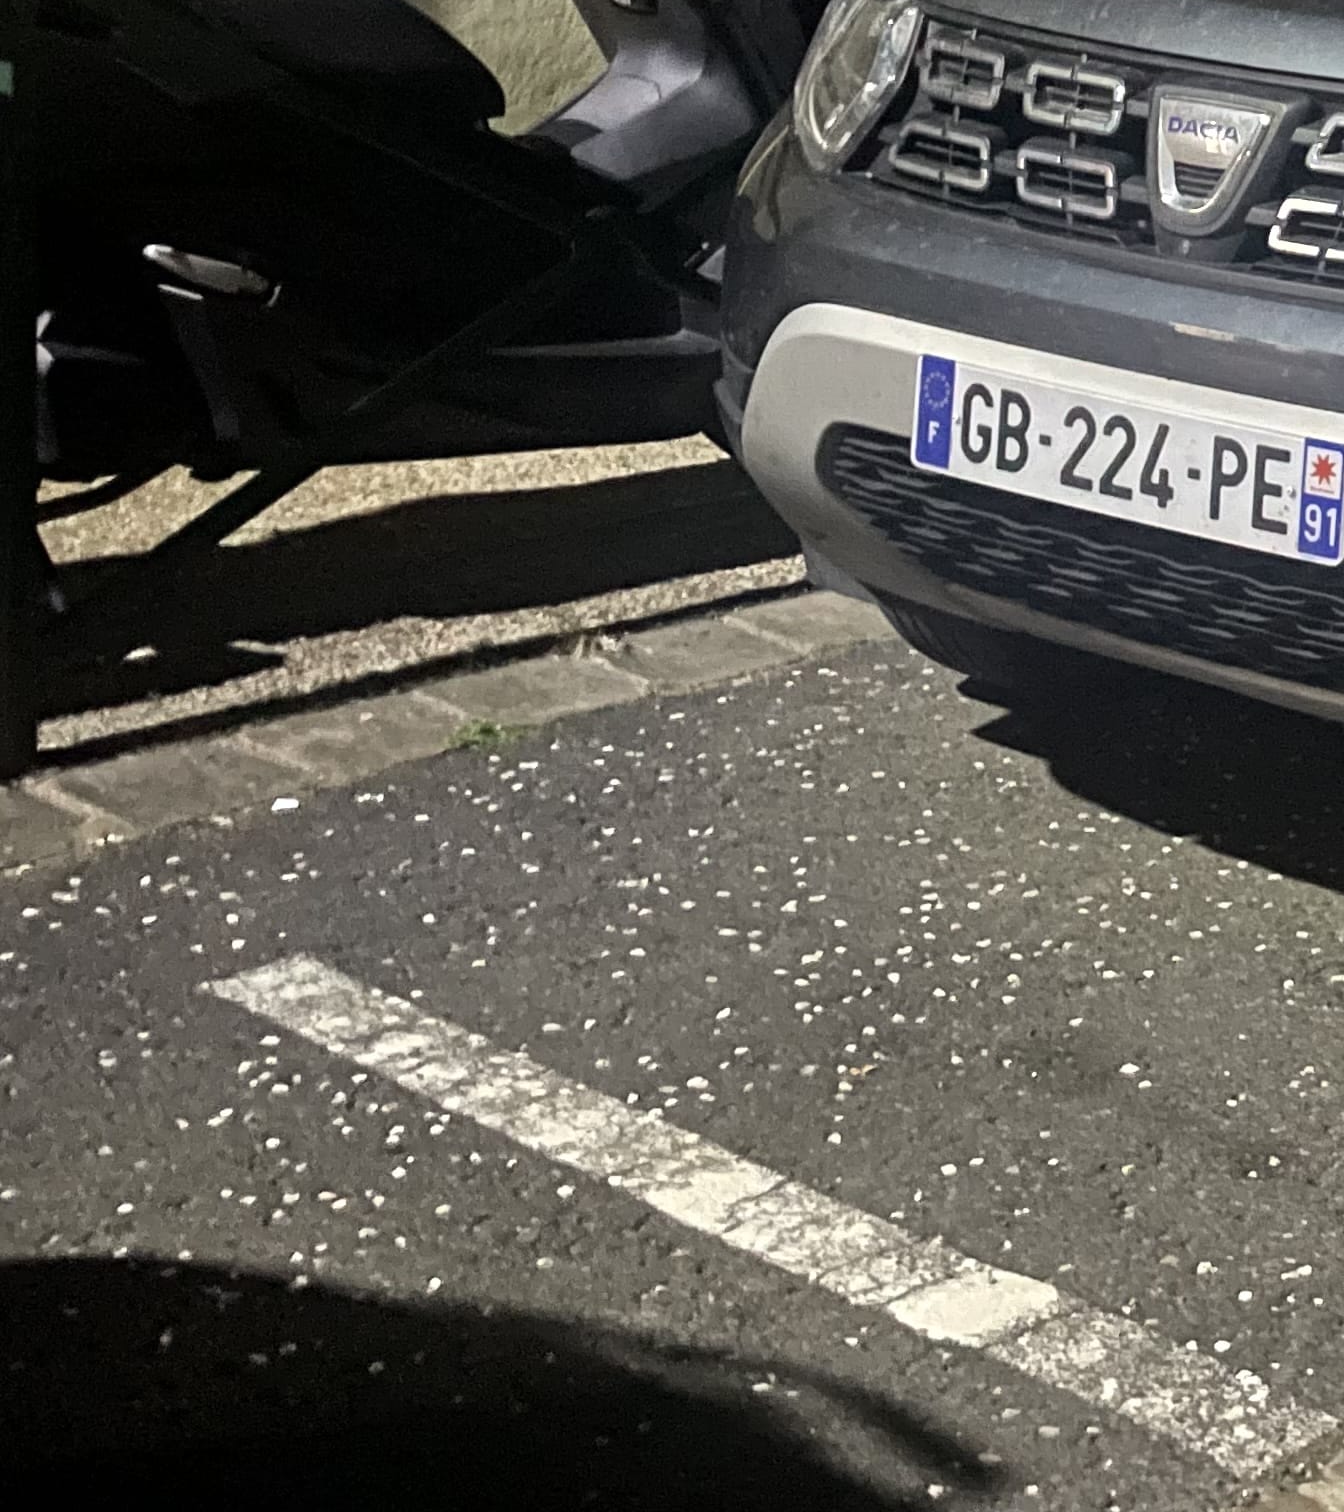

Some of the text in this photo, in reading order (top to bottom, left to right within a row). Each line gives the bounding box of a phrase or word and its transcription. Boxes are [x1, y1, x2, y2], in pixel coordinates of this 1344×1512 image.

[1168, 116, 1240, 144] DACIA
[927, 383, 1338, 547] F GB-224-PE 91
